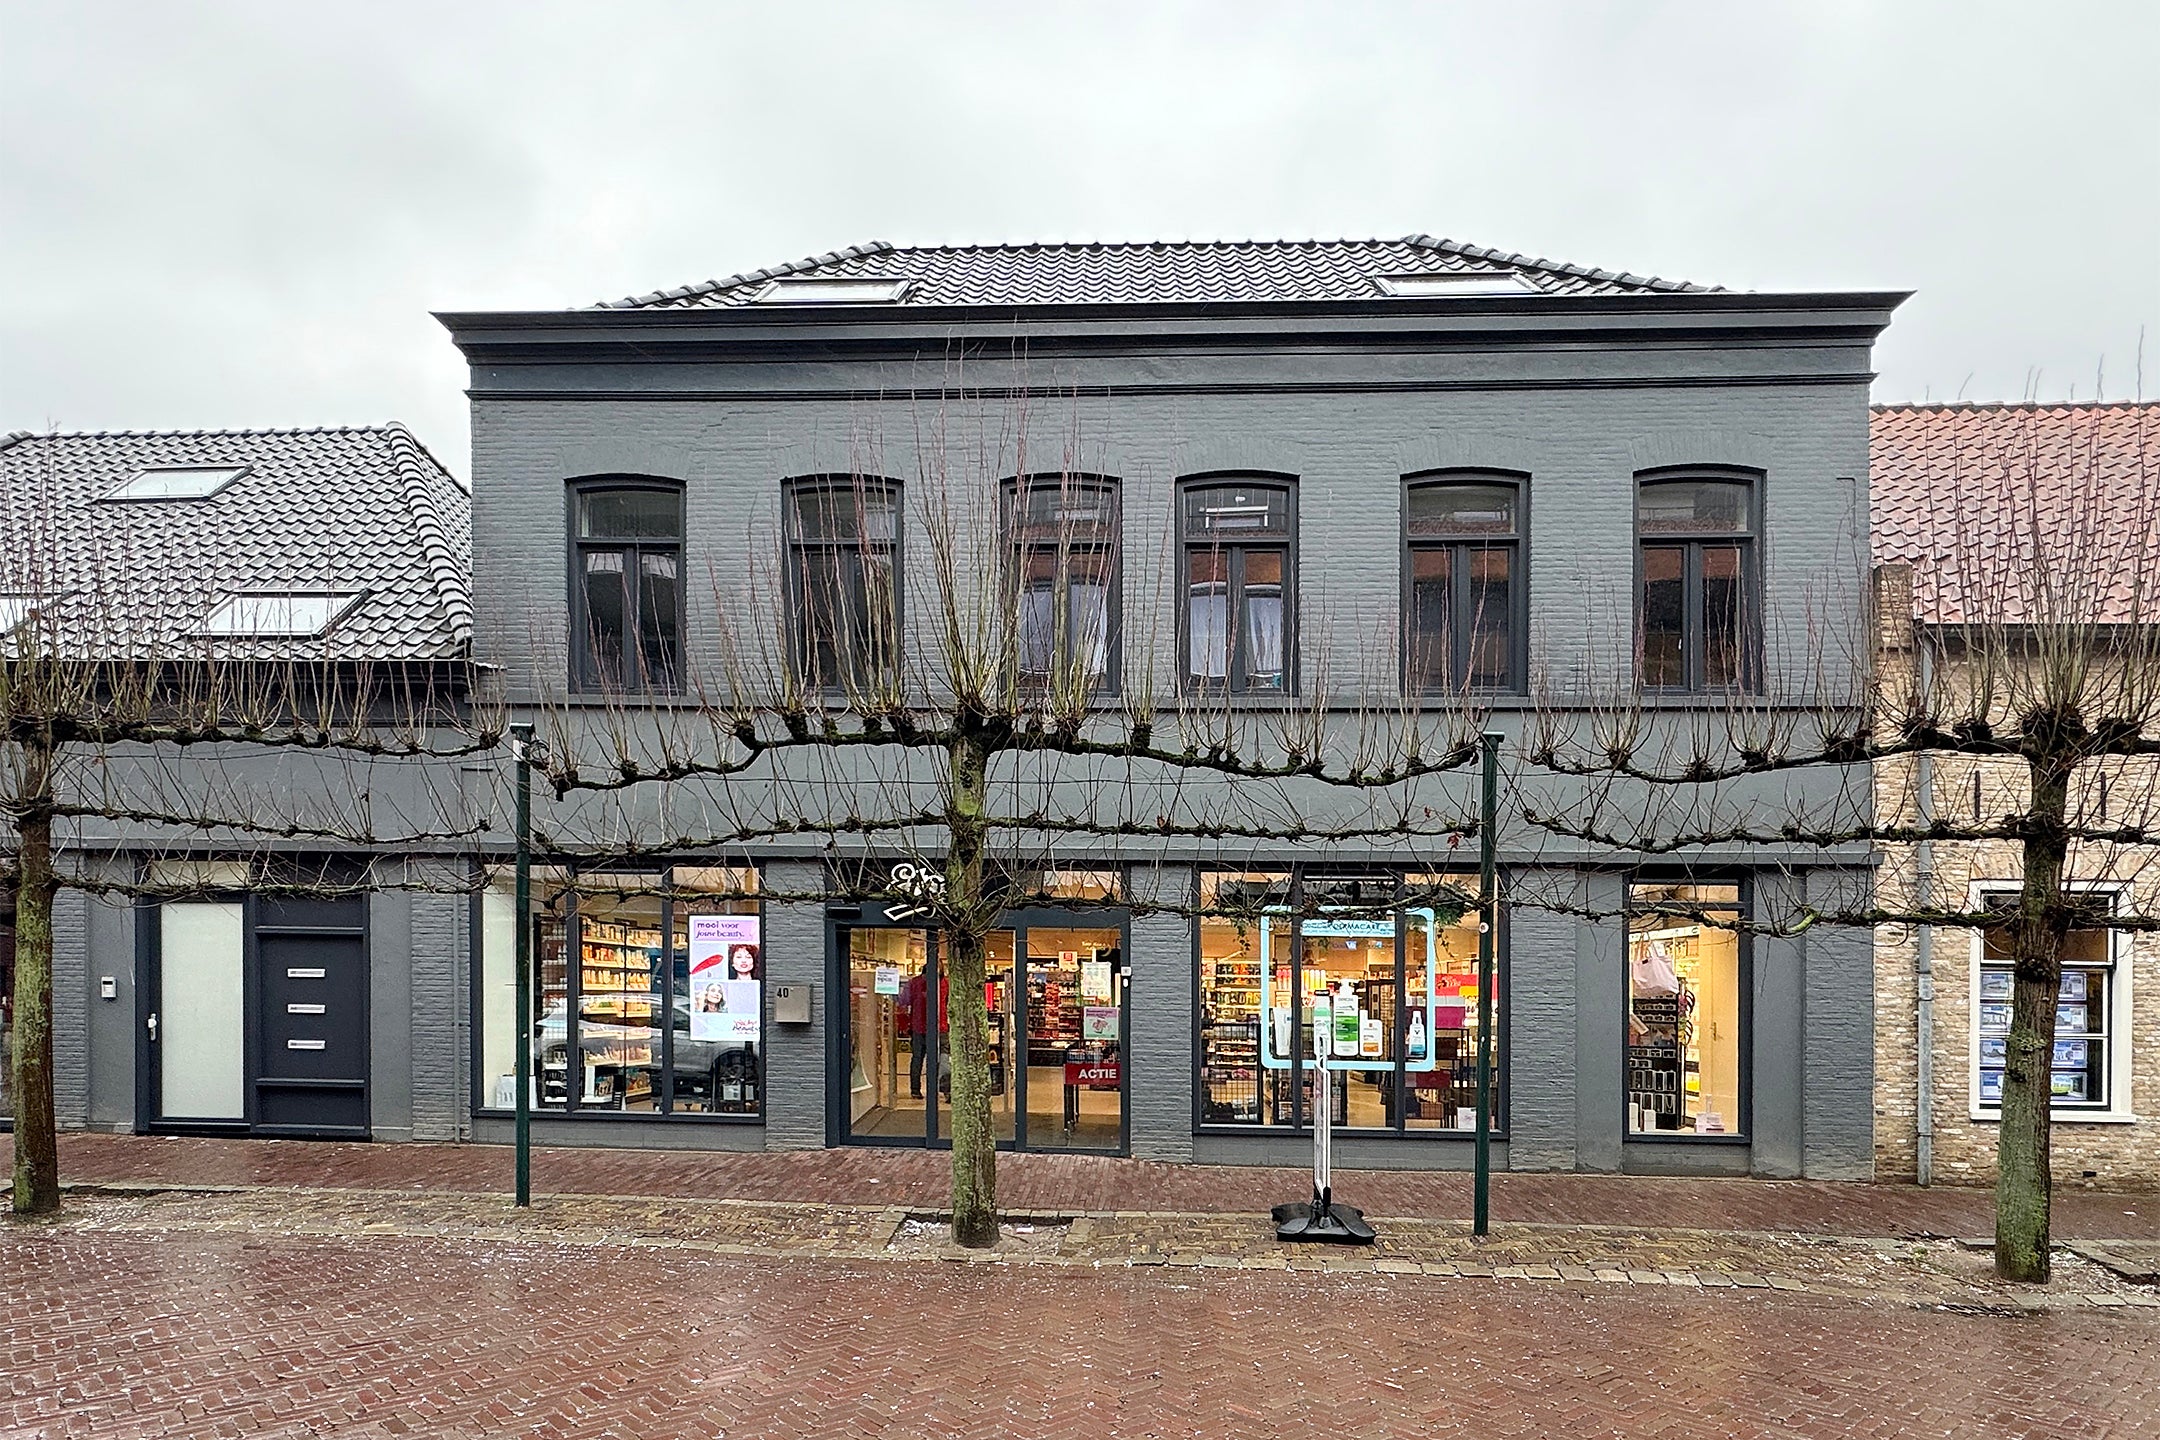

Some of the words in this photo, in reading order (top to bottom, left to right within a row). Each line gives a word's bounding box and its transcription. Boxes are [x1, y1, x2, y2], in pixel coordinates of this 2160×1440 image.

[697, 920, 719, 929] mooi
[776, 987, 789, 998] 40
[1078, 1068, 1117, 1079] ACTIE
